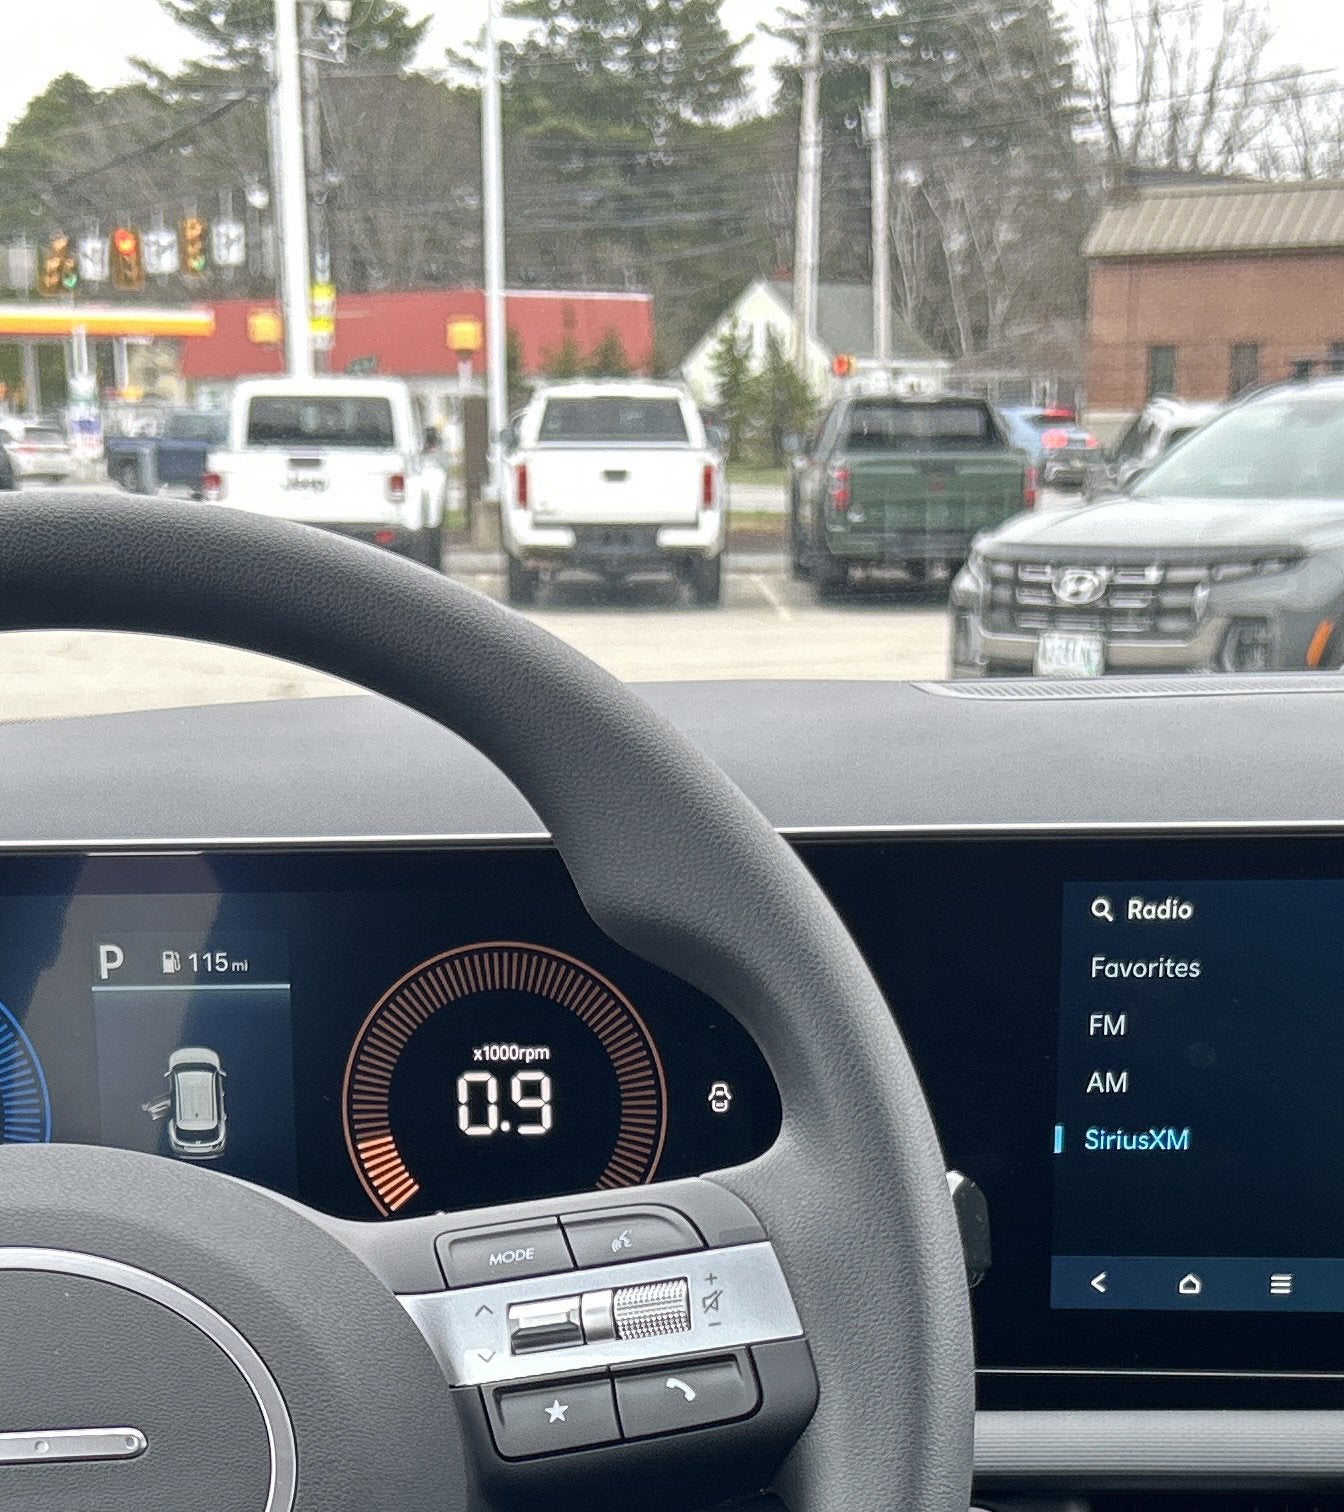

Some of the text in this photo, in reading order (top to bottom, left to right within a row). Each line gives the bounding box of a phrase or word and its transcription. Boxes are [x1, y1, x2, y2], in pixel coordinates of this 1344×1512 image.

[1127, 899, 1193, 921] Radio
[99, 945, 123, 979] P
[188, 952, 248, 973] 115 mi
[1091, 957, 1201, 980] Favorites
[1089, 1014, 1127, 1037] FM
[473, 1044, 550, 1062] x1000rpm
[1086, 1071, 1128, 1094] AM
[459, 1072, 553, 1135] 0.9
[1084, 1127, 1190, 1152] SiriusXM
[489, 1247, 535, 1266] MODE
